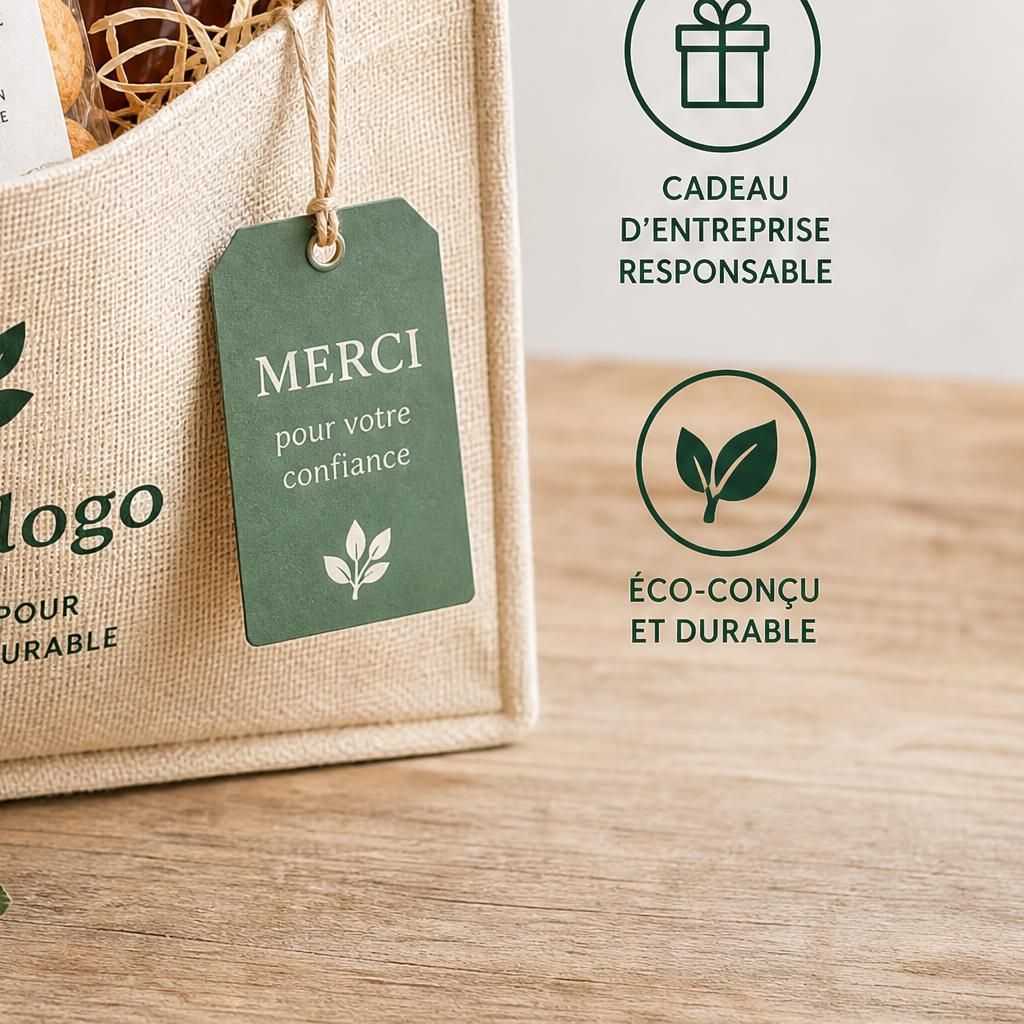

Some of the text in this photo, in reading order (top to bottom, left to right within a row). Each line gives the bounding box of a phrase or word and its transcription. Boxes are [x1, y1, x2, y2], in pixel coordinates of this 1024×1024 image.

[255, 328, 423, 397] MERCI
[275, 406, 411, 457] pour votre
[283, 447, 411, 489] confiance
